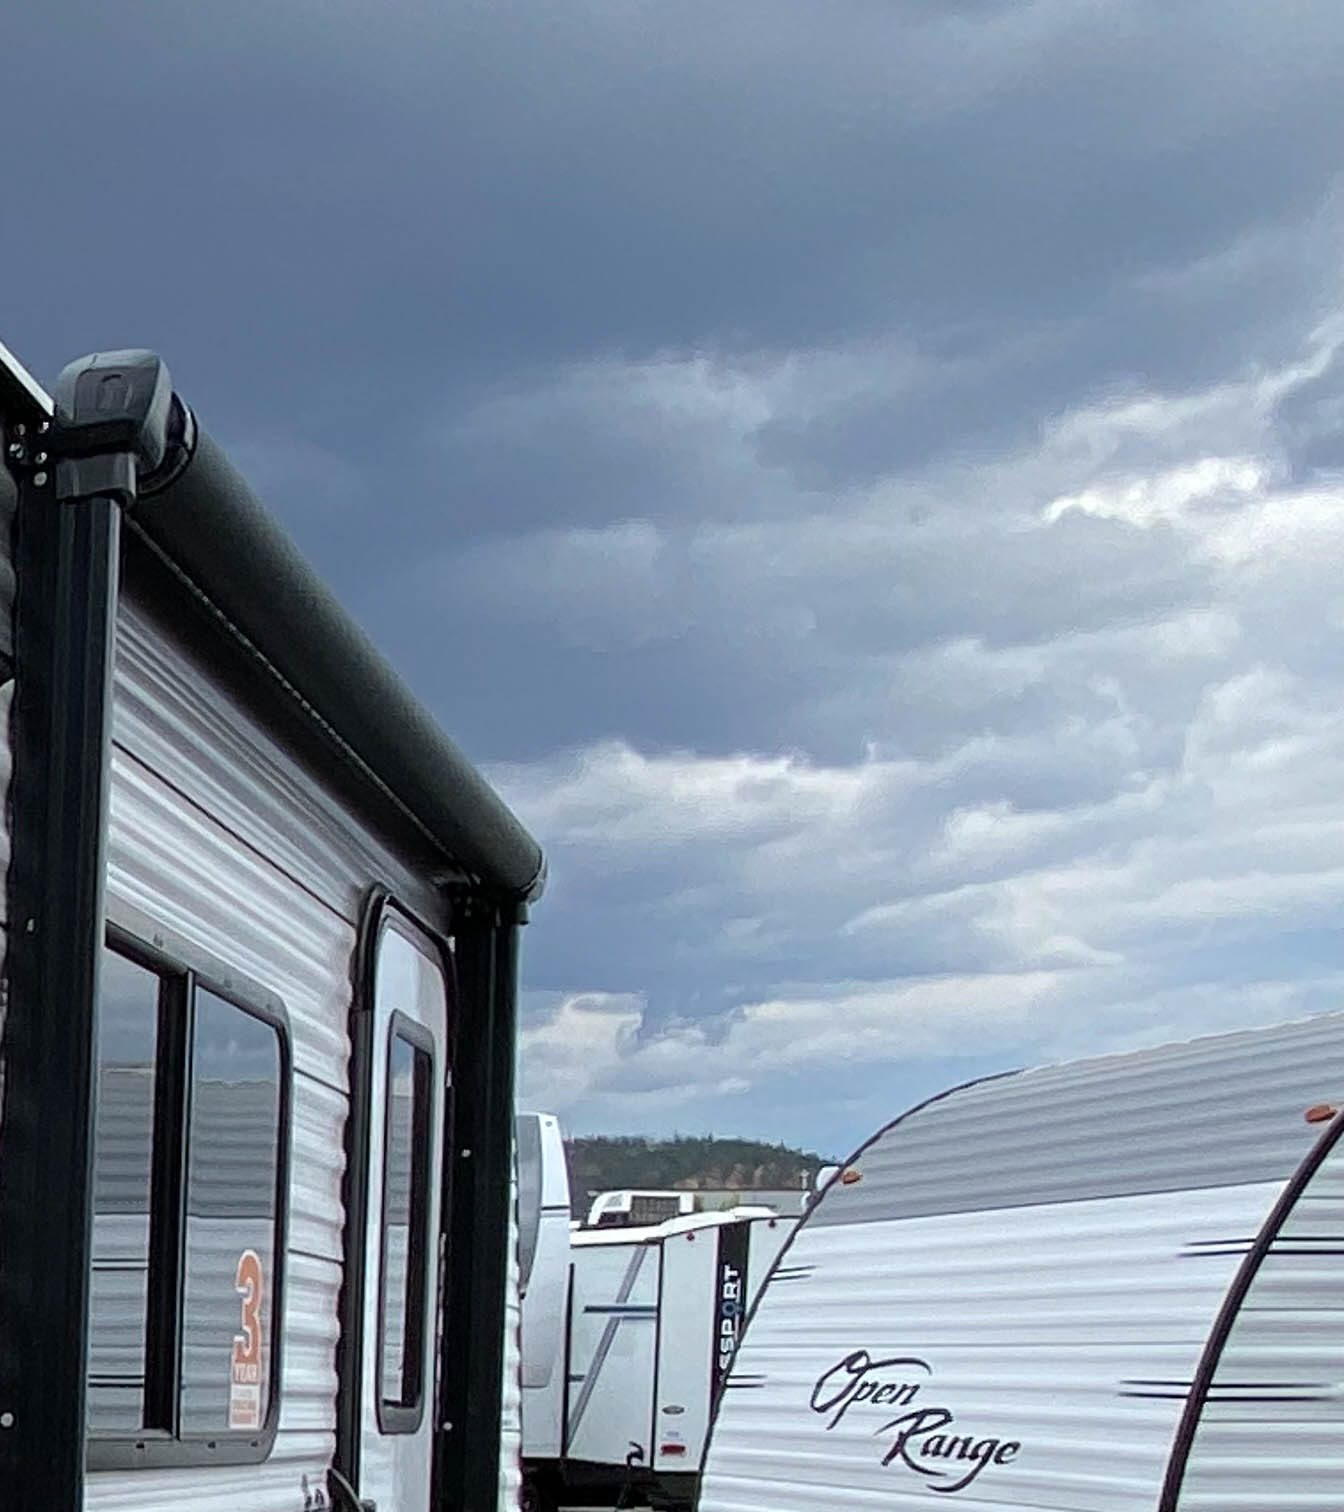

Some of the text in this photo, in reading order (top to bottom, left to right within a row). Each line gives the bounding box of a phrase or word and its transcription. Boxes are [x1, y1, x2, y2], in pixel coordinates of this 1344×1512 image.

[234, 1250, 262, 1362] 3
[718, 1264, 740, 1382] SSPORT
[810, 1350, 932, 1431] Open
[873, 1408, 1021, 1492] Range
